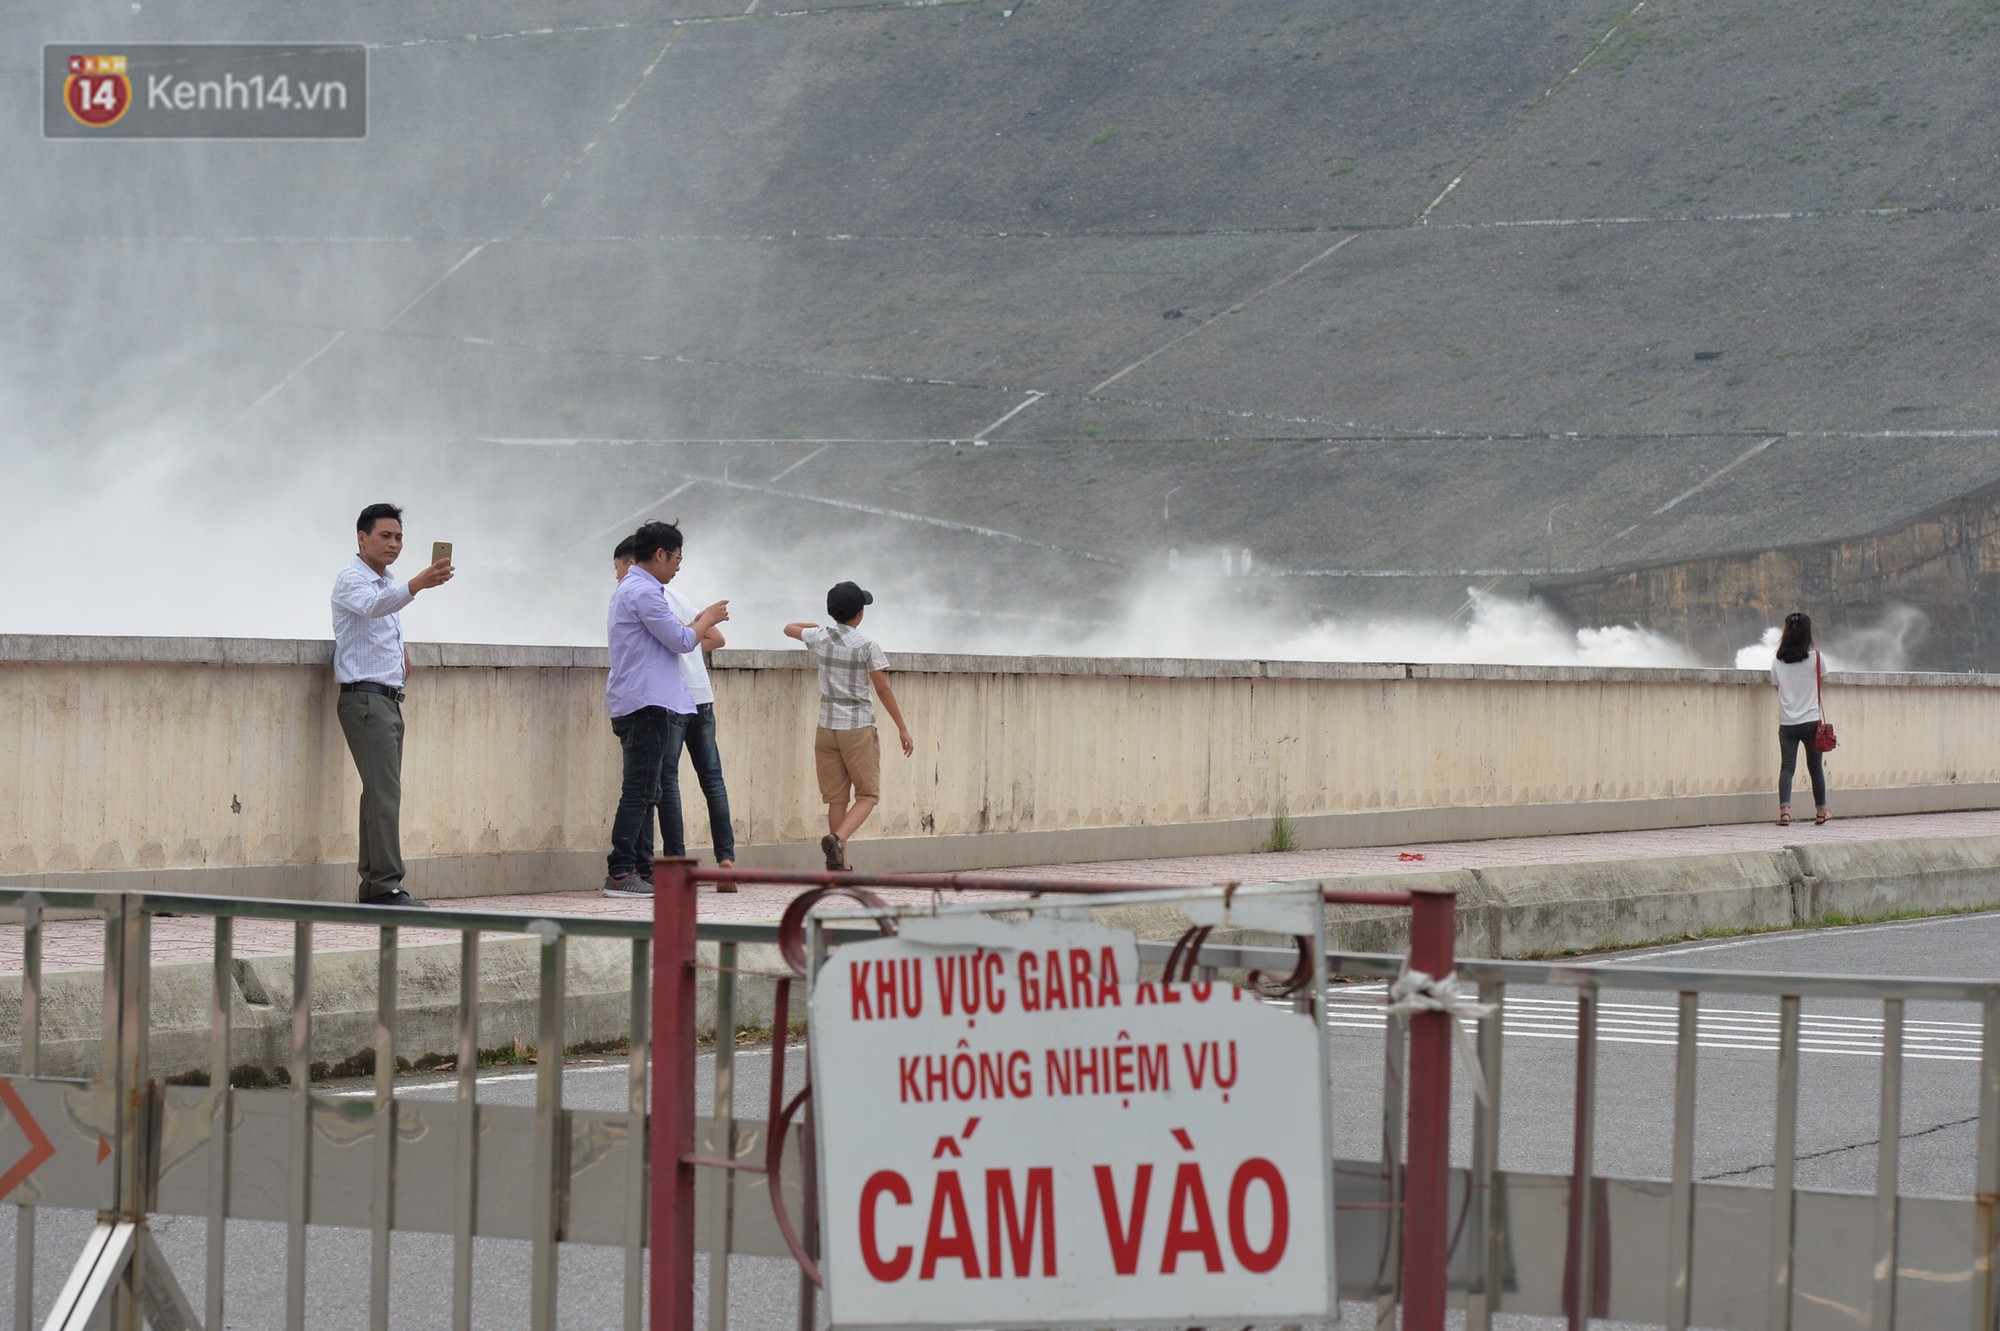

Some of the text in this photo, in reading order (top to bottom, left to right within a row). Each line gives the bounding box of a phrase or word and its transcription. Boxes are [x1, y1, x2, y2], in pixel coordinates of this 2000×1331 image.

[850, 946, 1121, 1028] KHU VỰC GARA
[899, 1030, 1238, 1108] KHÔNG NHIỆM VỤ
[858, 1116, 1290, 1283] CẤM VÀO
